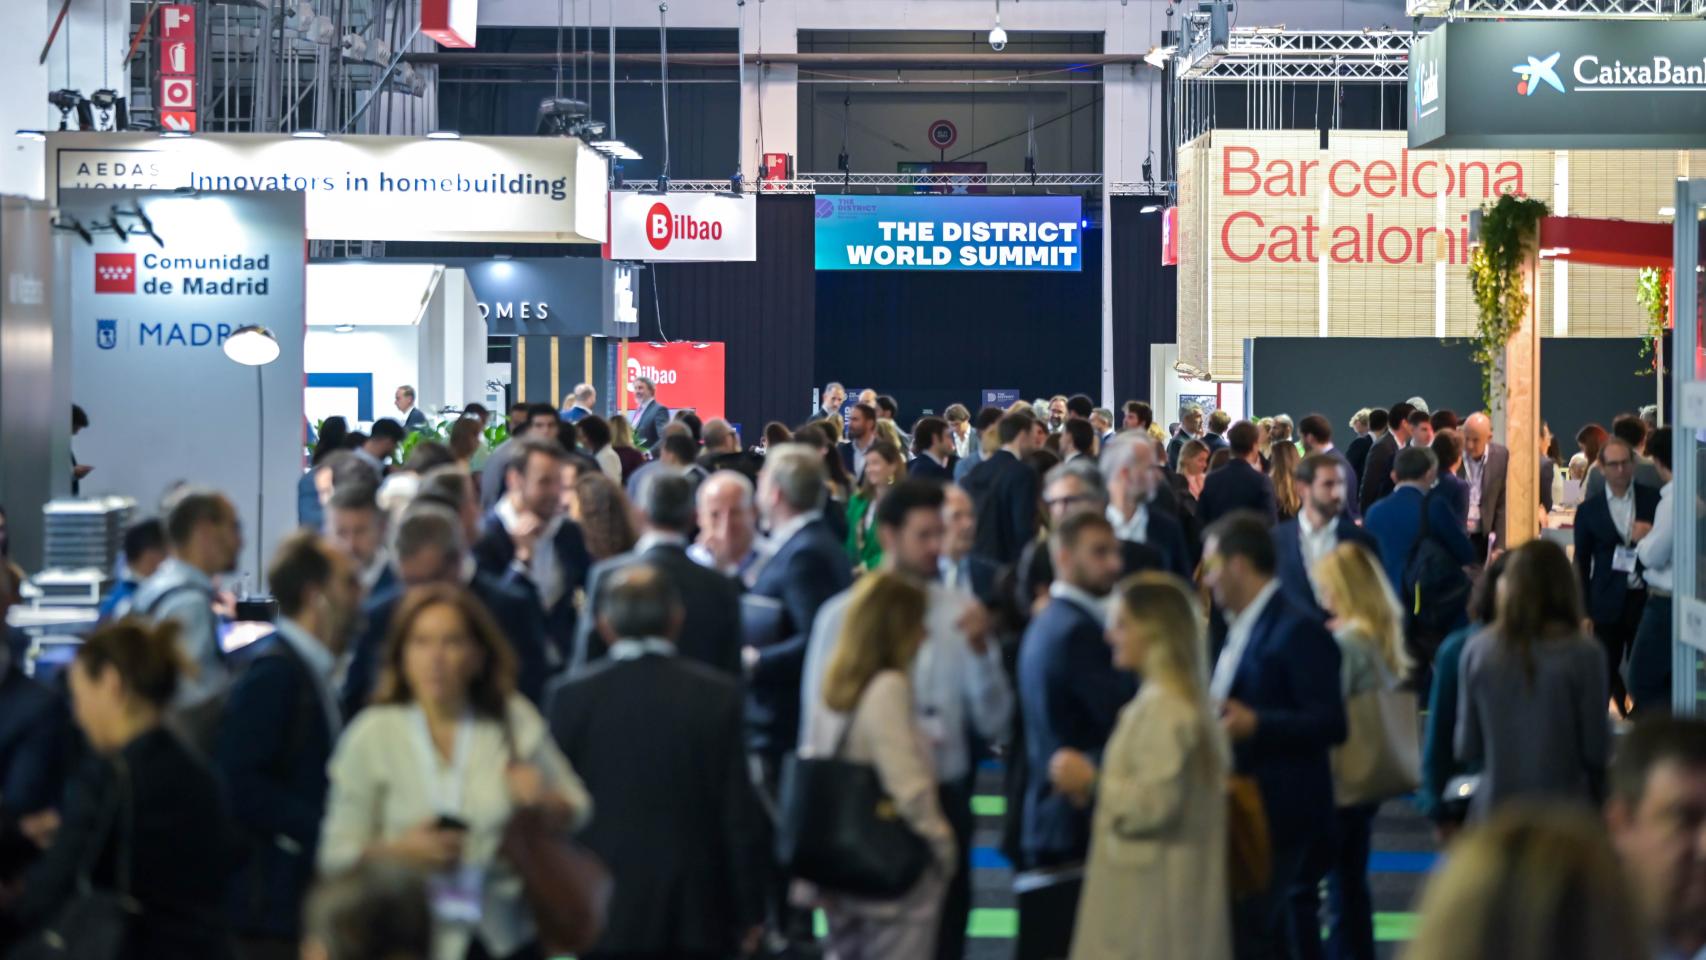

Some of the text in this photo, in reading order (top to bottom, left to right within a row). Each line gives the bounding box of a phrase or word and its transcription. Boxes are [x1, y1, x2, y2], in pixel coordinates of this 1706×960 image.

[77, 162, 160, 177] AEDAS
[1222, 145, 1526, 198] Barcelona
[190, 171, 566, 200] Innovators in homebuilding
[652, 213, 722, 240] Bilbao
[878, 221, 1077, 242] THE DISTRICT
[1220, 211, 1468, 264] Cataloni
[143, 253, 270, 270] Comunidad
[846, 245, 1077, 267] WORLD SUMMIT
[143, 277, 269, 296] de Madrid
[477, 302, 549, 319] OMES
[139, 322, 240, 346] MADR
[627, 366, 677, 384] Bilbao
